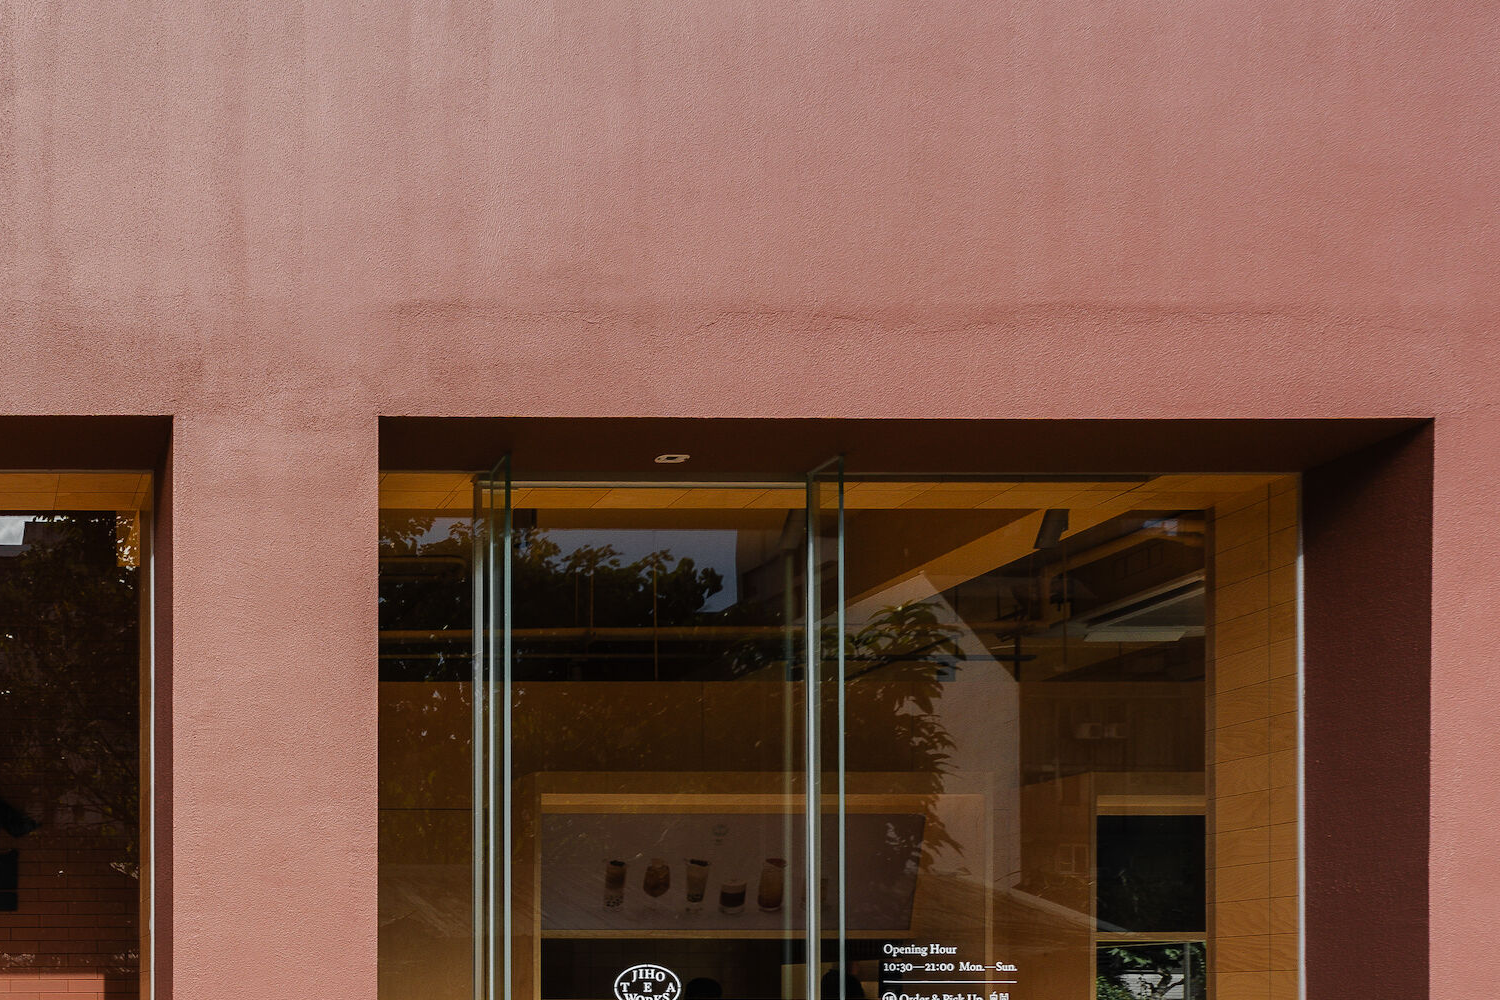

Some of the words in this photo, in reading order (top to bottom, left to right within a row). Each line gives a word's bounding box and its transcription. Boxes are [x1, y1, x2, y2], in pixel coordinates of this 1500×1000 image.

[883, 943, 928, 957] Opening
[930, 943, 957, 955] Hour
[632, 968, 665, 983] JIHO
